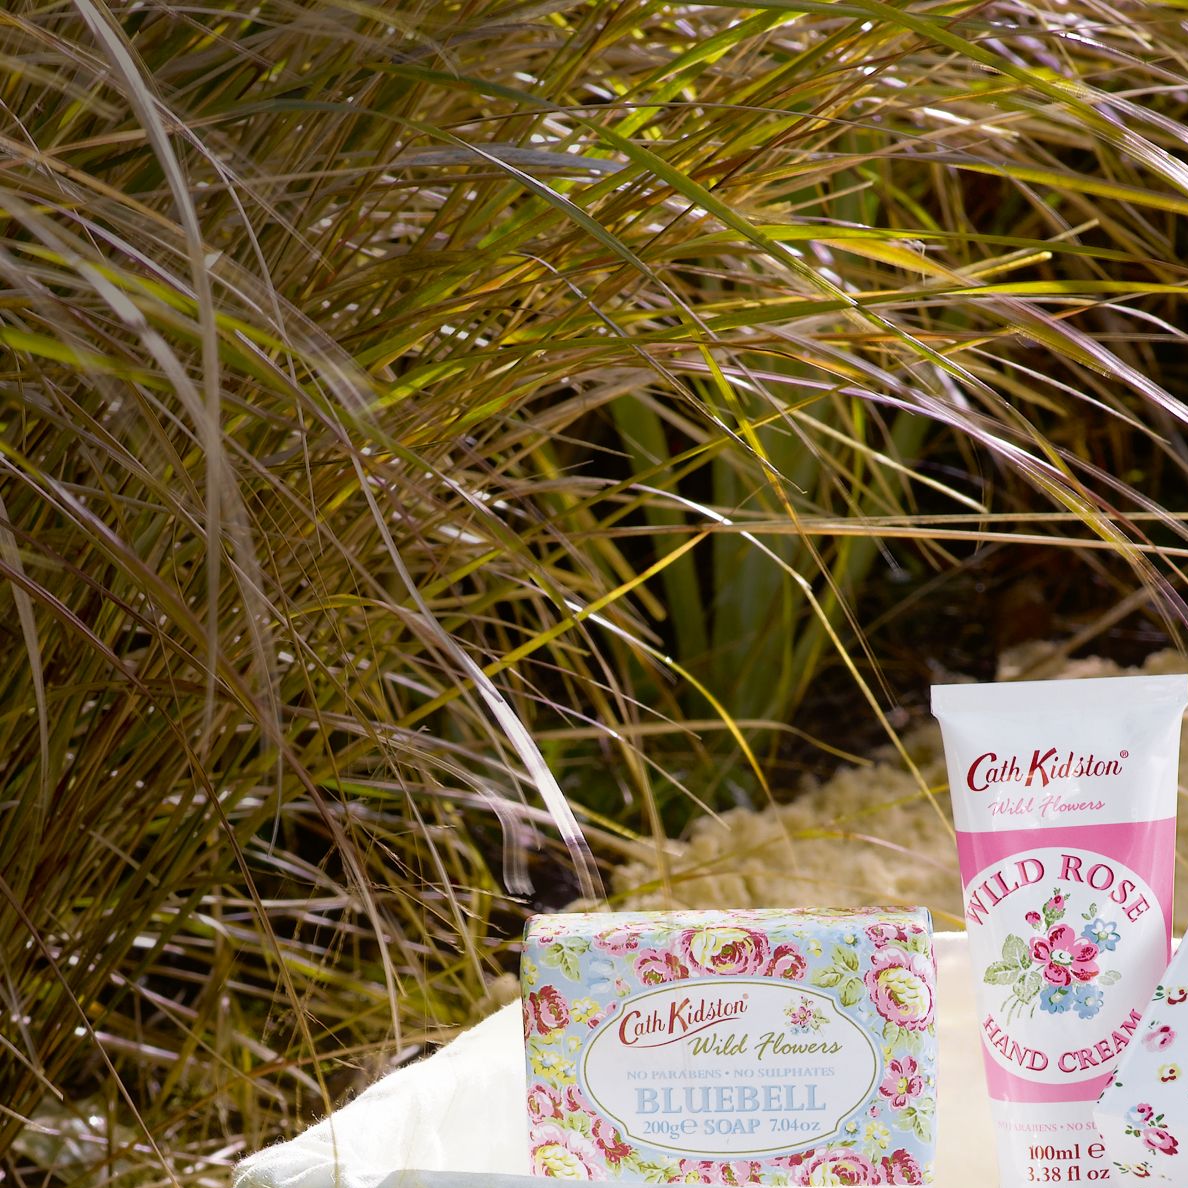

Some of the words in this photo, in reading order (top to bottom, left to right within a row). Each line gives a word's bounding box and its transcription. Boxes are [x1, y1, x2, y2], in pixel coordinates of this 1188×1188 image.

[967, 752, 1024, 792] Cath
[1025, 748, 1122, 787] Kidston
[988, 798, 1033, 816] Wild
[1039, 795, 1105, 817] Flowers
[965, 858, 1045, 926] WILD
[1057, 854, 1151, 923] ROSE
[619, 1010, 666, 1046] Cath
[668, 997, 748, 1034] Kidston
[688, 1033, 747, 1056] Wild
[755, 1031, 843, 1060] Flowers
[982, 1013, 1049, 1071] HAND
[1057, 1008, 1143, 1073] CREAM
[627, 1070, 648, 1080] NO
[649, 1069, 722, 1080] PARABENS
[734, 1068, 755, 1078] NO
[757, 1066, 835, 1078] SULPHATES
[635, 1084, 827, 1115] BLUEBELL
[703, 1119, 760, 1136] SOAP
[1066, 1121, 1083, 1132] NO
[1029, 1144, 1080, 1160] 100ml
[1027, 1166, 1061, 1182] 3.38
[1067, 1165, 1081, 1181] fl
[1087, 1168, 1110, 1180] oz
